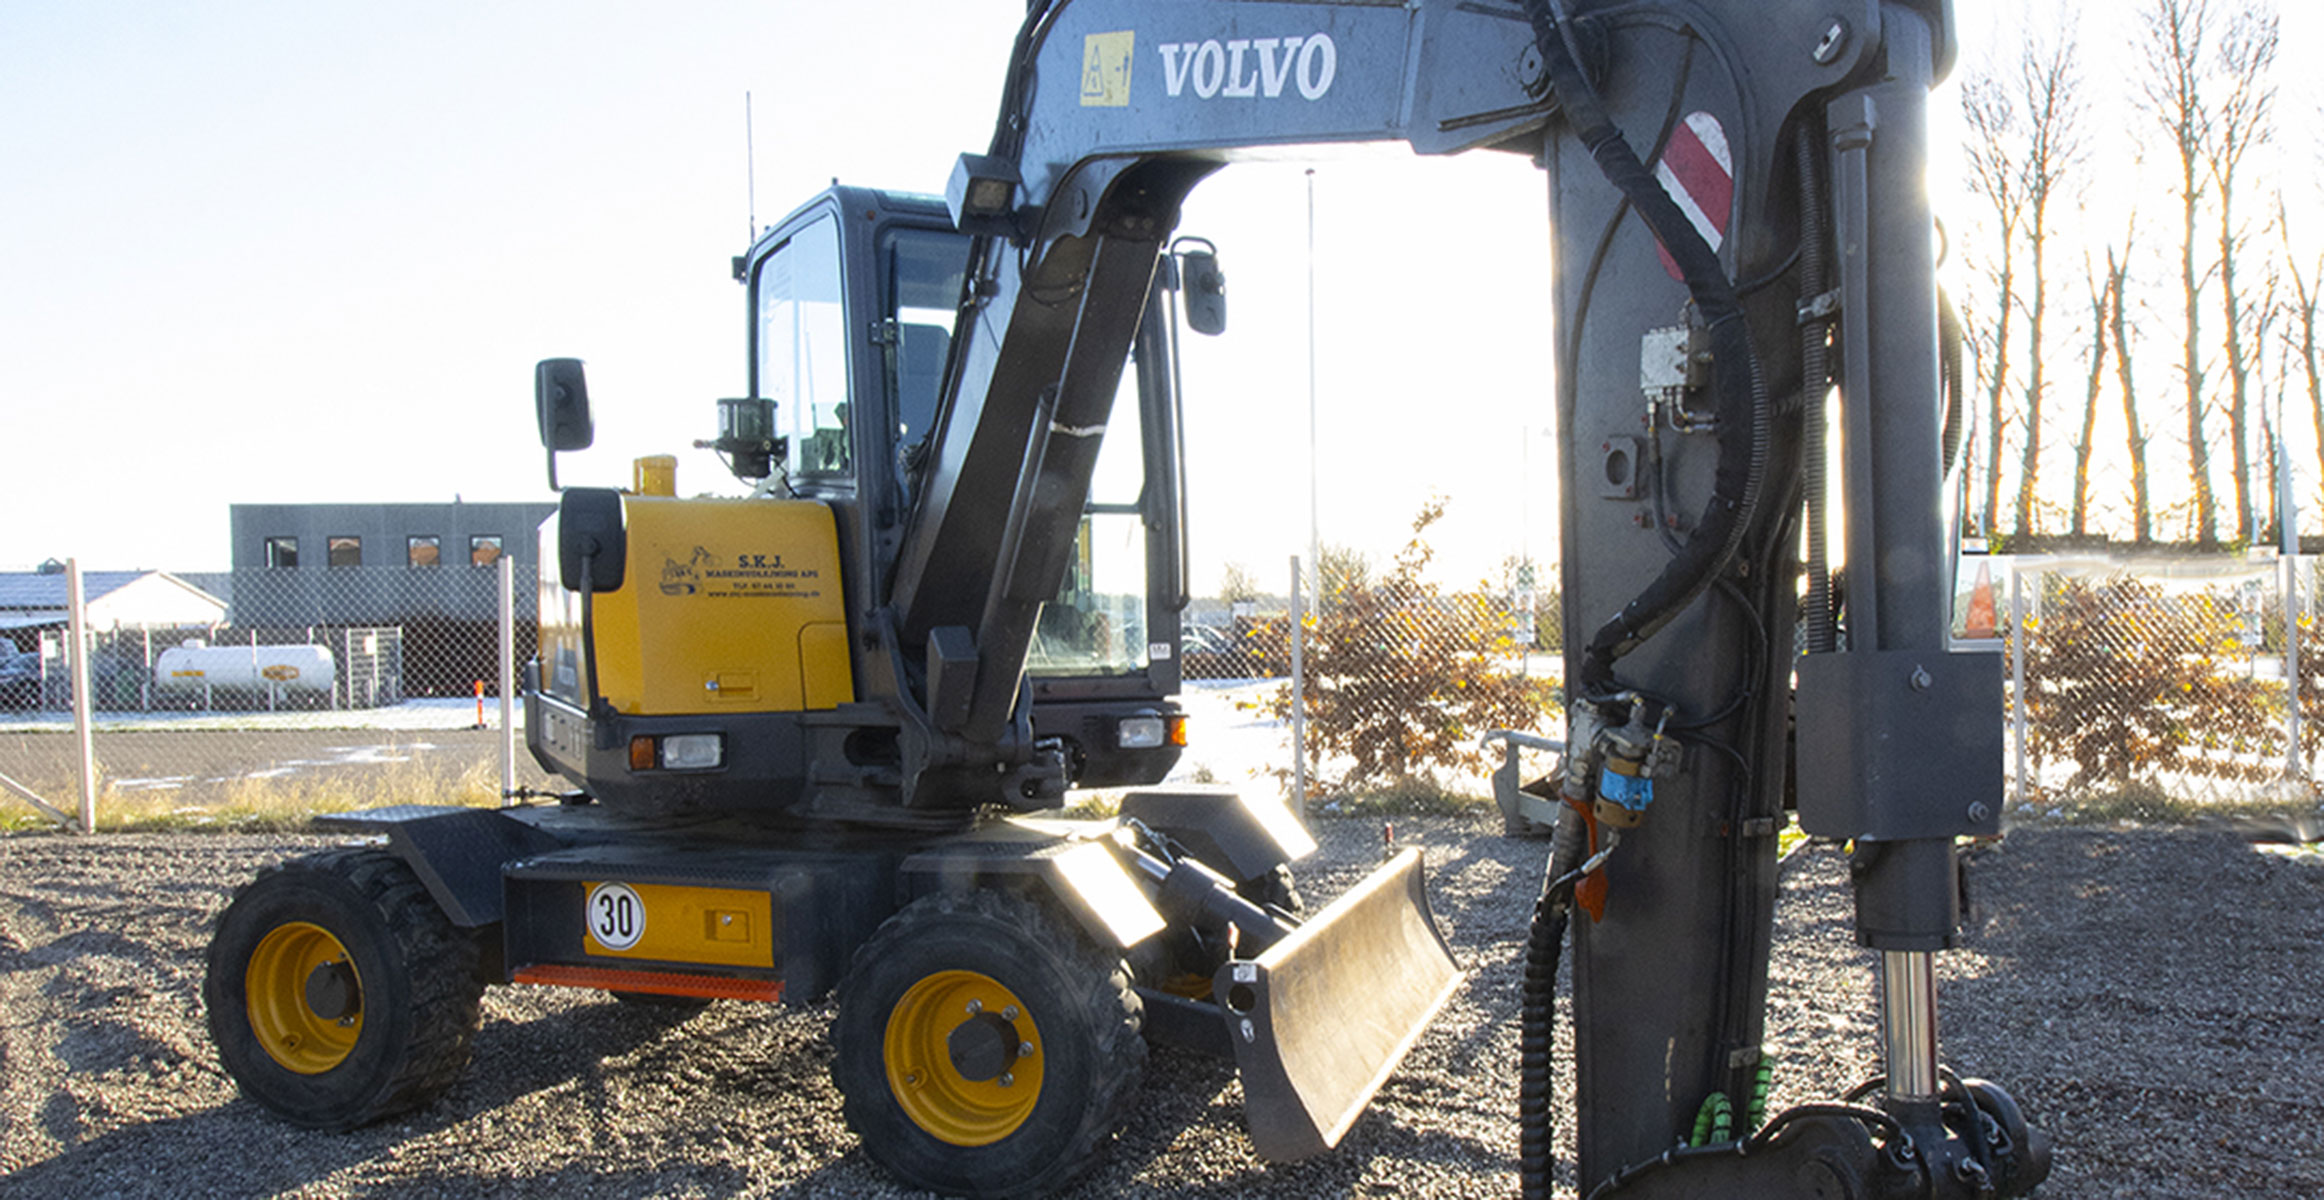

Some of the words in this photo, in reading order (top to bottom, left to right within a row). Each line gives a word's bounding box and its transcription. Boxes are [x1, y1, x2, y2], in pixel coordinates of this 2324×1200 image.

[1158, 32, 1337, 101] VOLVO
[738, 554, 785, 568] S.K.J.
[599, 893, 633, 938] 30
